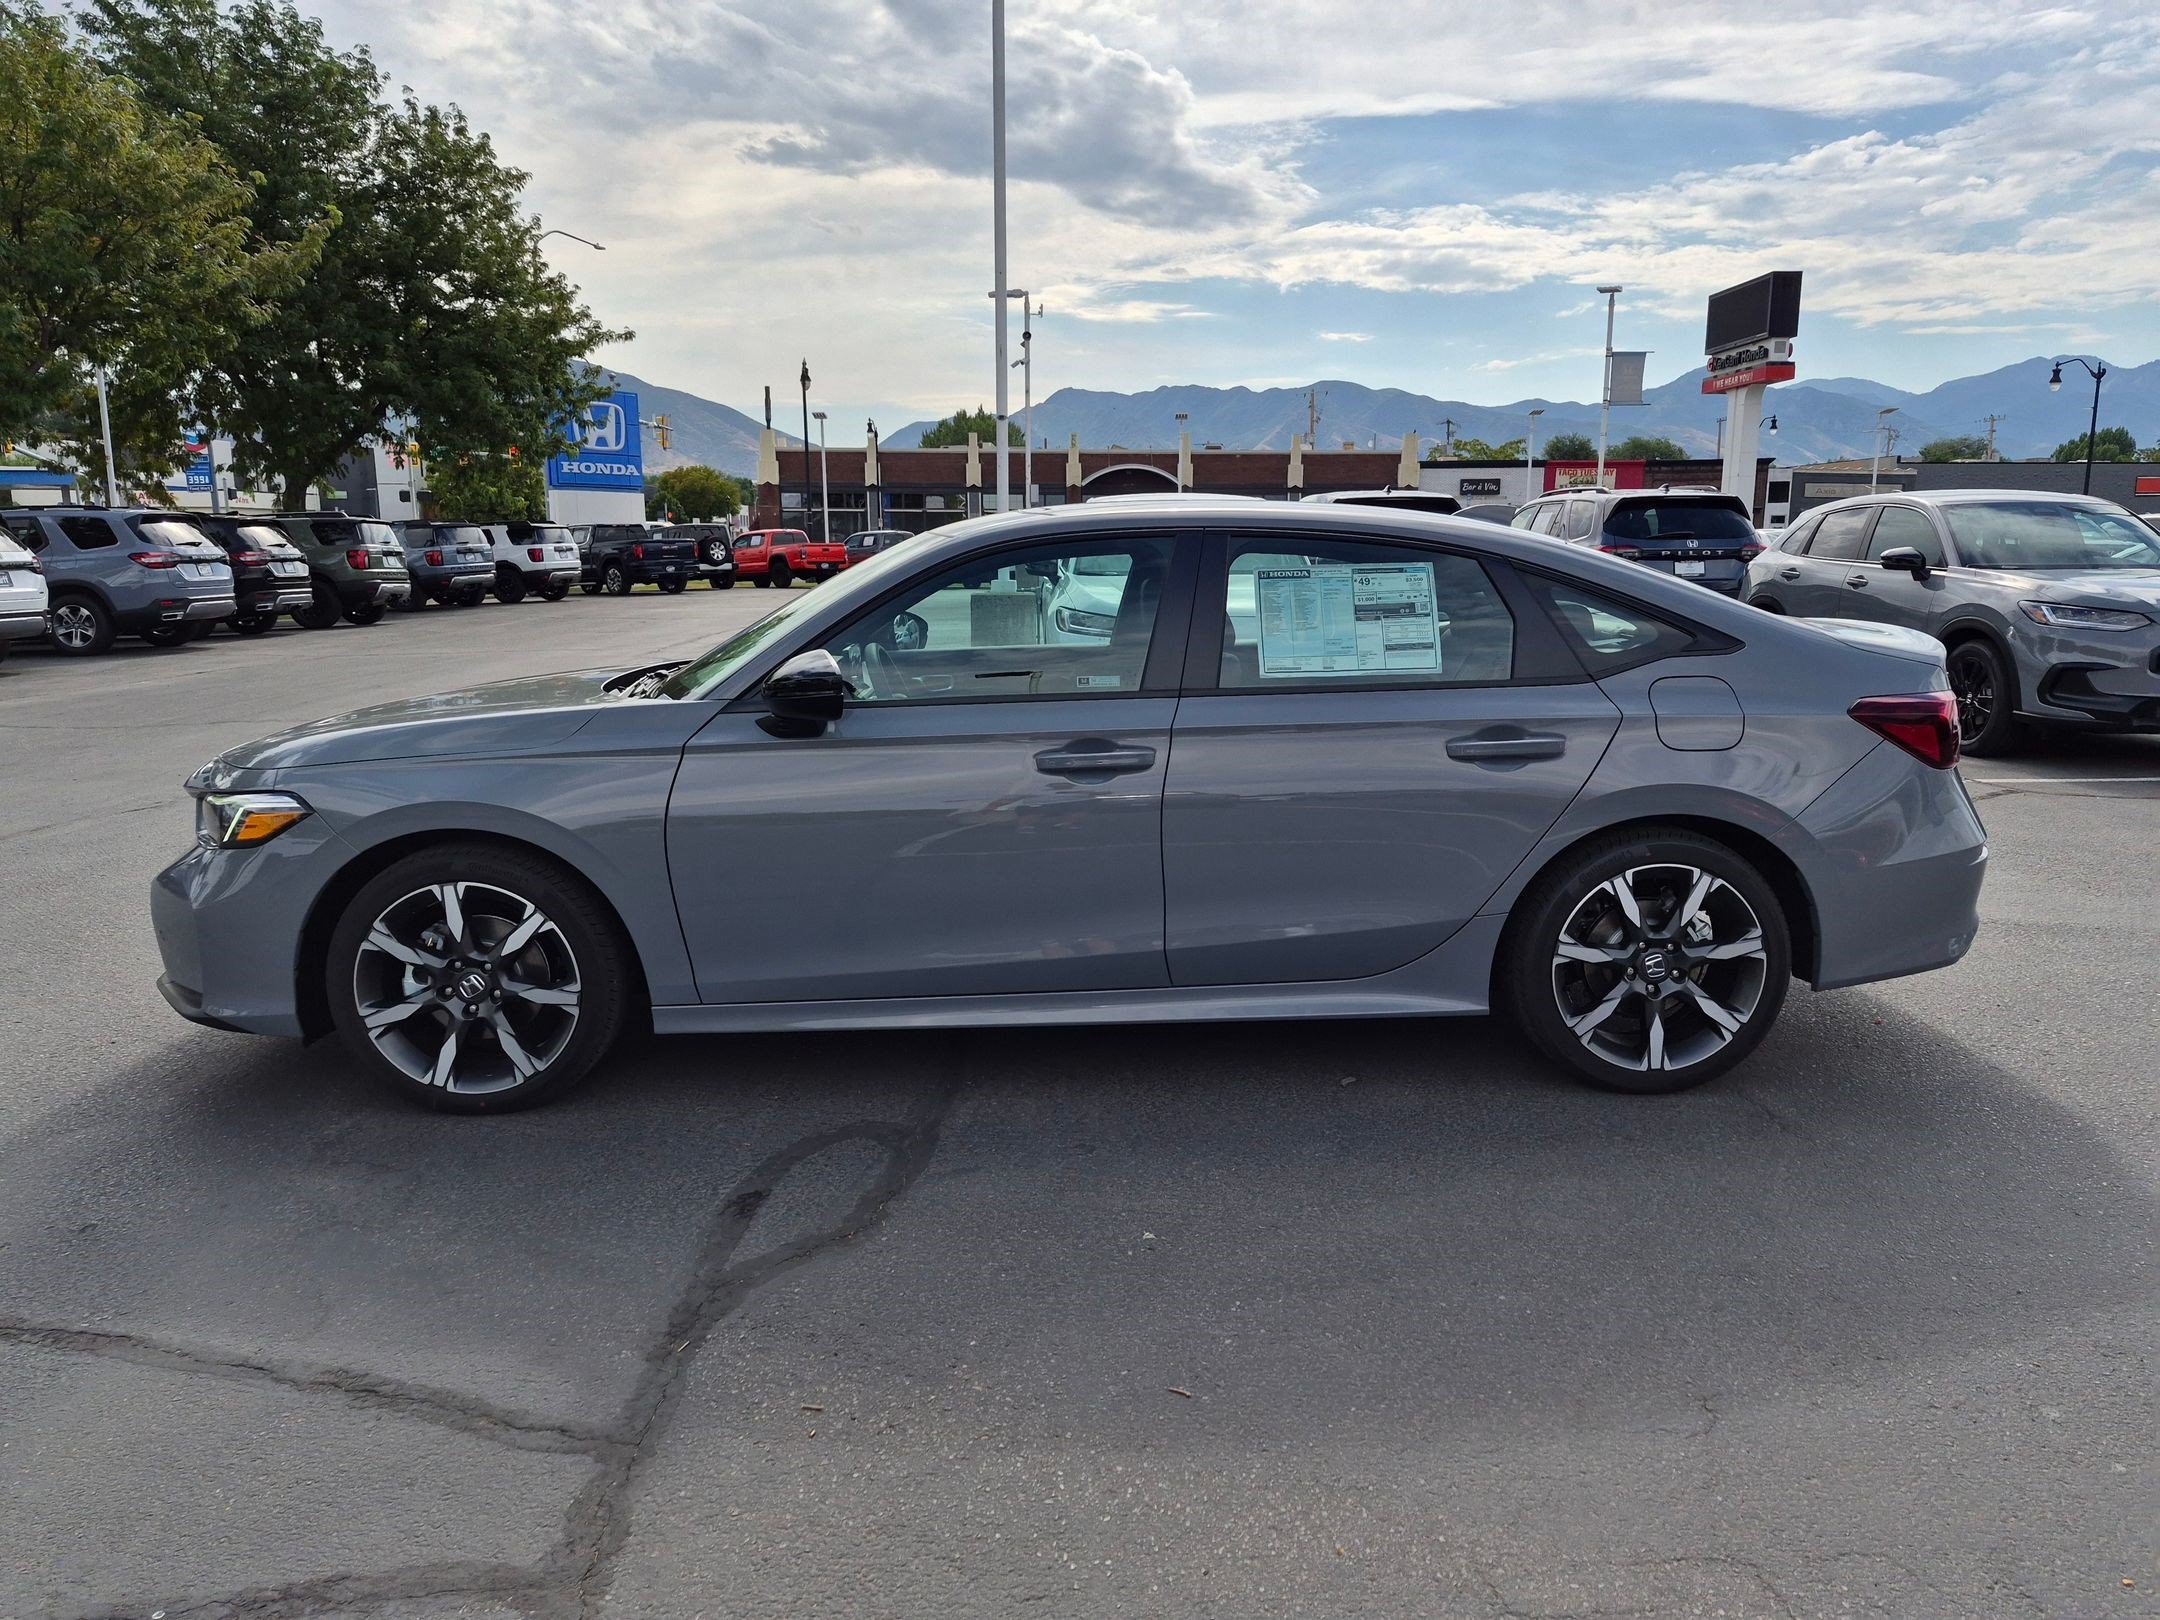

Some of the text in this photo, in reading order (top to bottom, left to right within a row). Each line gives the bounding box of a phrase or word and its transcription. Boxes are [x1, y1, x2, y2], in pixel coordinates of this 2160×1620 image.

[1724, 376, 1739, 386] HEAR
[560, 461, 640, 476] HONDA
[1558, 468, 1615, 477] TACO TUESAY
[1462, 482, 1477, 491] Bar
[1484, 482, 1499, 491] Vin
[1269, 570, 1310, 578] HONDA
[1358, 577, 1371, 586] 49
